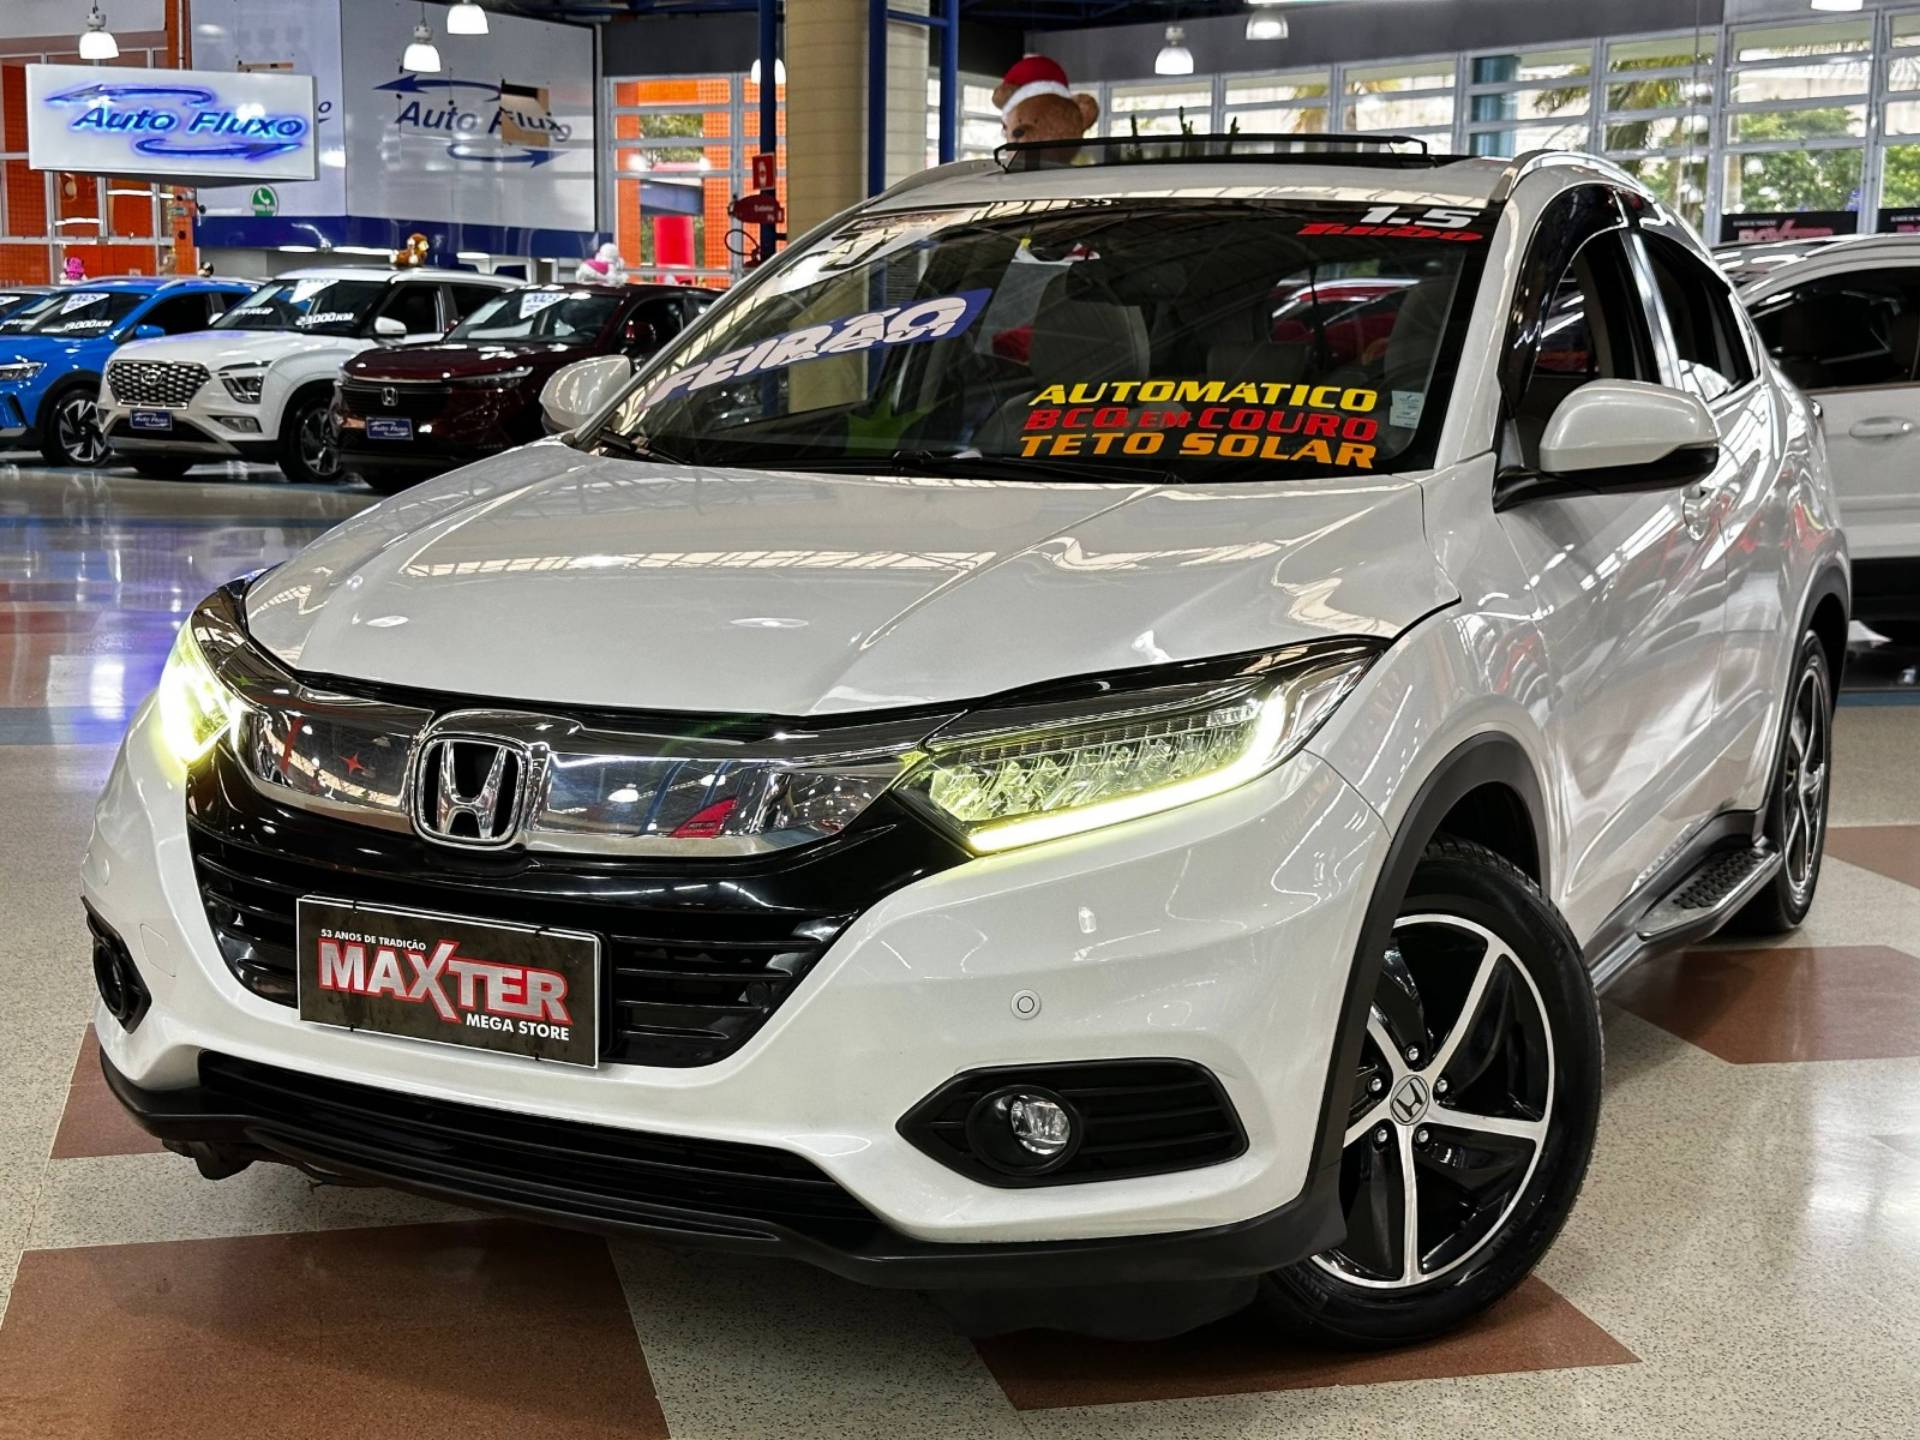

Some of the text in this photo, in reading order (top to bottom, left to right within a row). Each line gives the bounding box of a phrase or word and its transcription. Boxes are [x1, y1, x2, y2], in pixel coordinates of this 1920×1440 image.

[72, 107, 303, 136] Auto Fluxo
[394, 101, 477, 131] Auto
[1360, 206, 1480, 228] 1.5
[1199, 407, 1378, 441] COURO
[1020, 432, 1377, 469] TETO SOLAR
[321, 928, 427, 951] 53 ANOS DE TRADIÇÃO
[318, 939, 574, 1025] MAXTER
[466, 1012, 570, 1041] MEGA STORE
